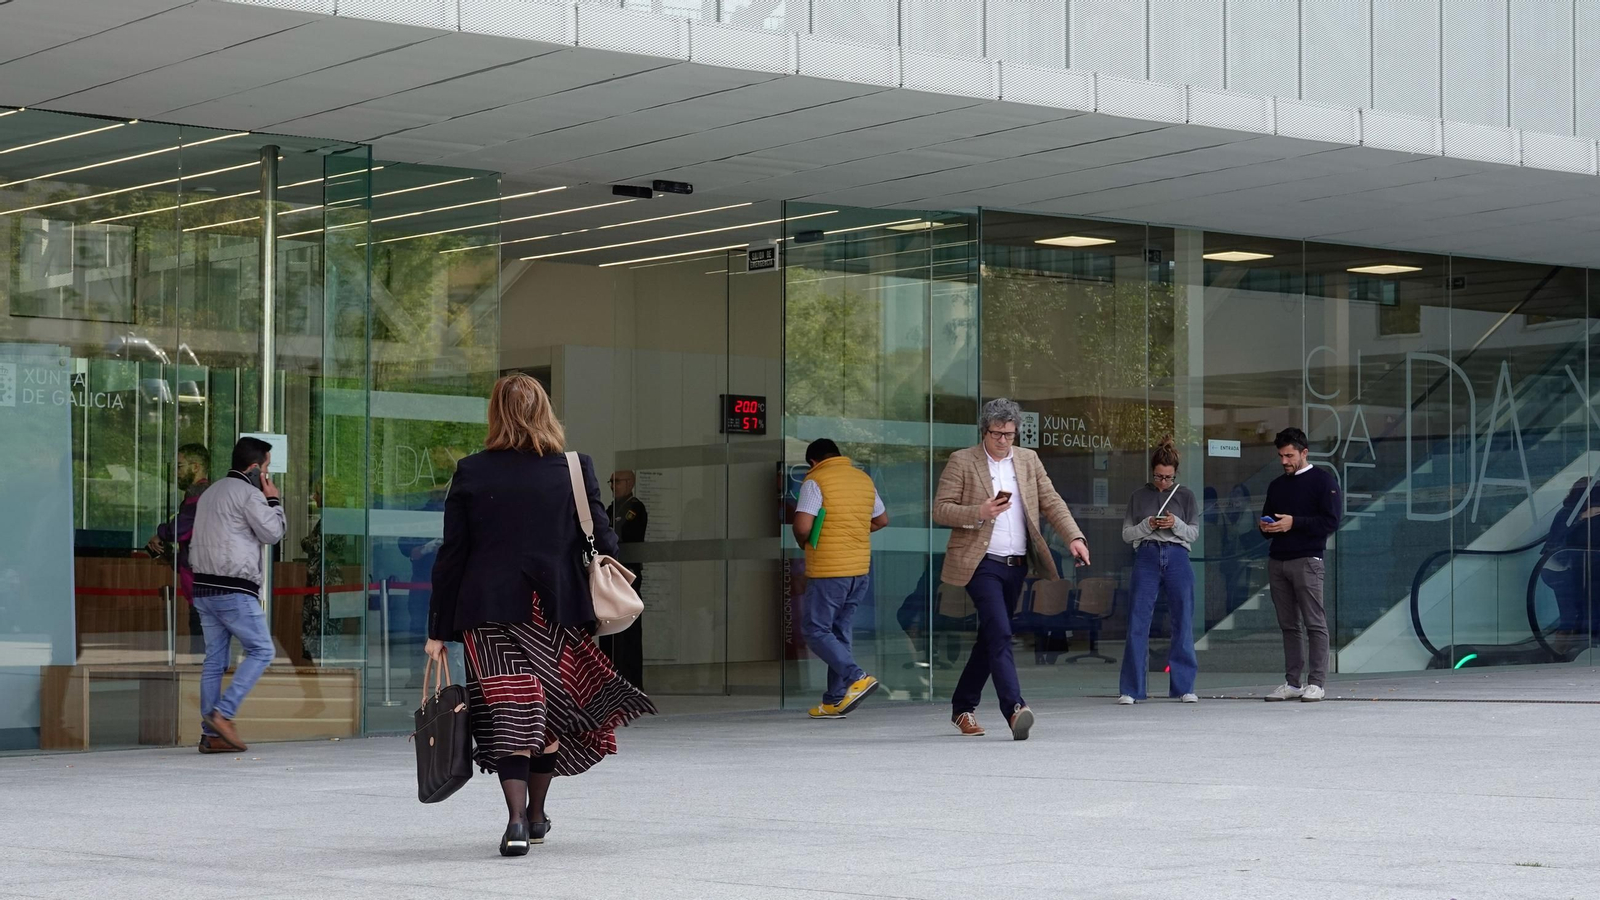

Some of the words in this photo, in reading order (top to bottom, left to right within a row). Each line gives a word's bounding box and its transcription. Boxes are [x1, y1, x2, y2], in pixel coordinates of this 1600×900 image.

[23, 367, 86, 388] XUNTA
[22, 388, 45, 405] DE
[52, 389, 124, 409] GALICIA
[743, 417, 758, 429] 57
[1043, 415, 1086, 432] XUNTA
[1043, 432, 1059, 447] DE
[1062, 433, 1112, 449] GALICIA
[1406, 352, 1539, 525] DA
[784, 585, 792, 596] AL
